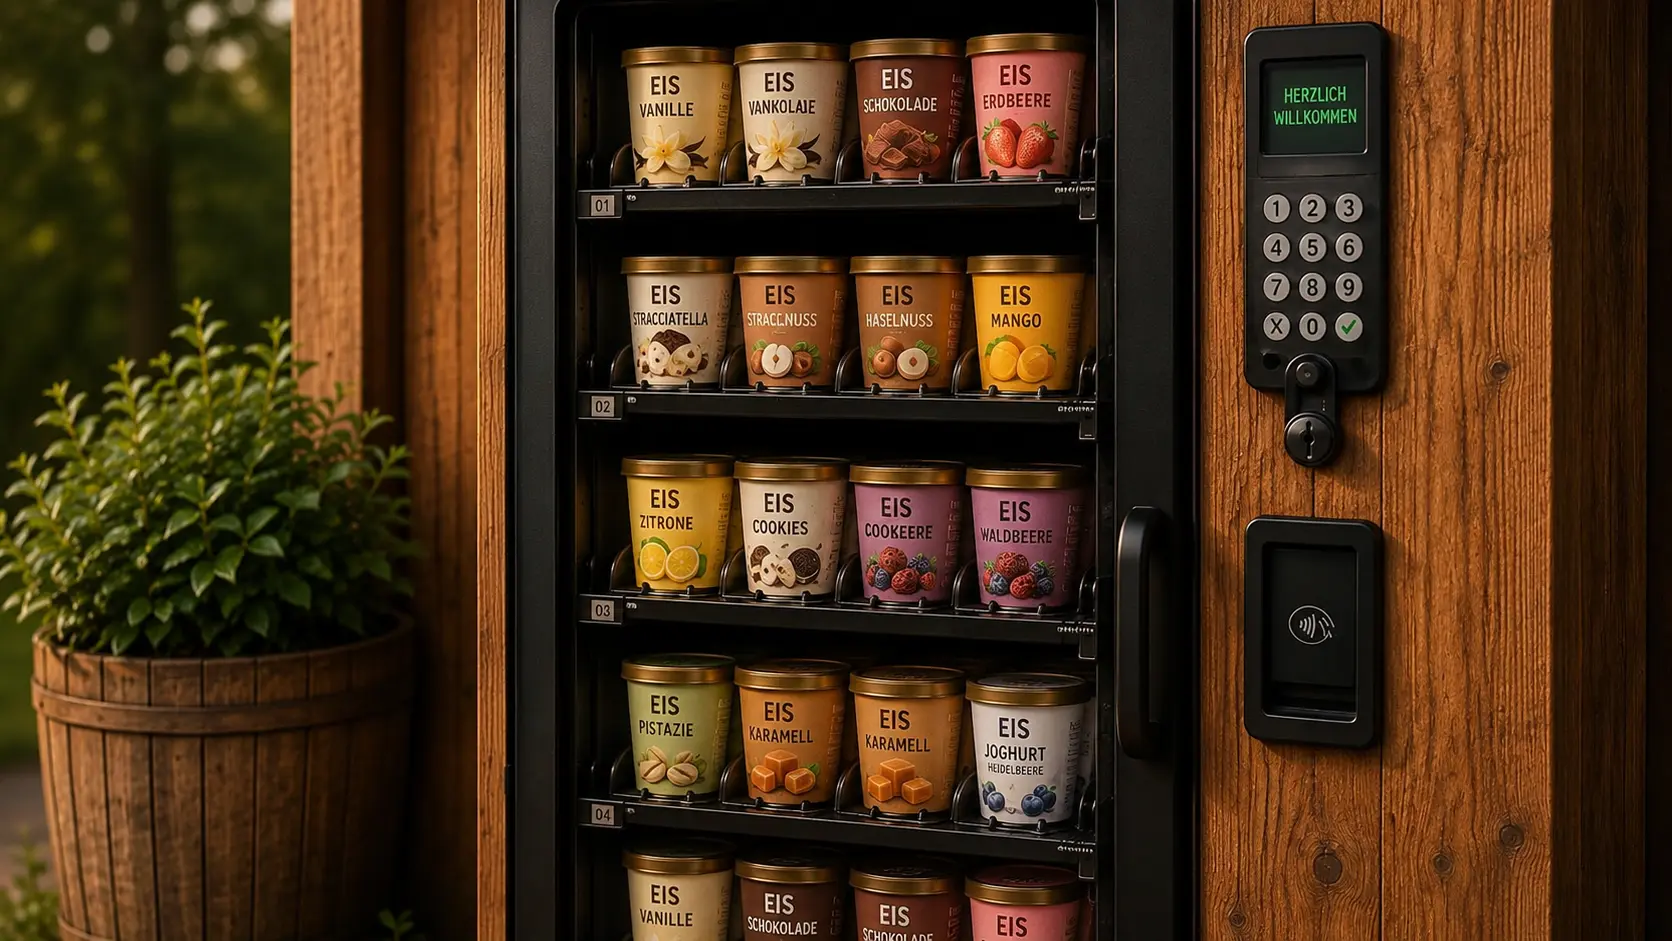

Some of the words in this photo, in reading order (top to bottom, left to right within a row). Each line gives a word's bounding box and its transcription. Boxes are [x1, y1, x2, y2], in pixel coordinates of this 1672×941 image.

[764, 72, 795, 92] EIS
[881, 67, 913, 90] EIS
[1000, 64, 1032, 86] EIS
[650, 75, 680, 96] EIS
[983, 92, 1052, 110] ERDBEERE
[1284, 86, 1347, 104] HERZLICH
[640, 102, 694, 118] VANILLE
[863, 96, 937, 113] SCHOKOLADE
[1273, 108, 1358, 126] WILLKOMMEN
[595, 200, 610, 212] 01
[1272, 200, 1279, 217] 1
[1307, 199, 1318, 217] 2
[1343, 199, 1354, 217] 3
[1270, 239, 1282, 256] 4
[1307, 239, 1318, 256] 5
[1343, 238, 1355, 256] 6
[650, 284, 681, 305] EIS
[765, 285, 796, 305] EIS
[882, 285, 913, 306] EIS
[1000, 285, 1032, 306] EIS
[1271, 278, 1282, 296] 7
[1307, 278, 1318, 296] 8
[1343, 278, 1354, 296] 9
[632, 311, 708, 326] STRACCIATELLA
[866, 313, 934, 328] HASELNUSS
[991, 313, 1041, 328] MANGO
[1270, 318, 1283, 334] X
[1307, 318, 1318, 335] 0
[595, 400, 610, 413] 02
[650, 489, 680, 509] EIS
[764, 493, 794, 513] EIS
[881, 497, 912, 518] EIS
[1000, 500, 1031, 522] EIS
[640, 514, 694, 530] ZITRONE
[752, 519, 808, 535] COOKIES
[980, 527, 1053, 544] WALDBEERE
[595, 604, 611, 617] 03
[650, 694, 680, 716] EIS
[764, 701, 794, 722] EIS
[639, 719, 694, 737] PISTAZIE
[880, 708, 910, 730] EIS
[998, 717, 1030, 739] EIS
[749, 726, 814, 744] KARAMELL
[865, 733, 930, 752] KARAMELL
[984, 744, 1046, 762] JOGHURT
[988, 762, 1044, 776] HEIDELBEERE
[595, 808, 611, 821] 04
[650, 884, 680, 906] EIS
[764, 892, 794, 915] EIS
[640, 908, 693, 927] VANILLE
[880, 904, 910, 927] EIS
[747, 916, 818, 936] SCHOKOLADE
[996, 914, 1028, 938] EIS
